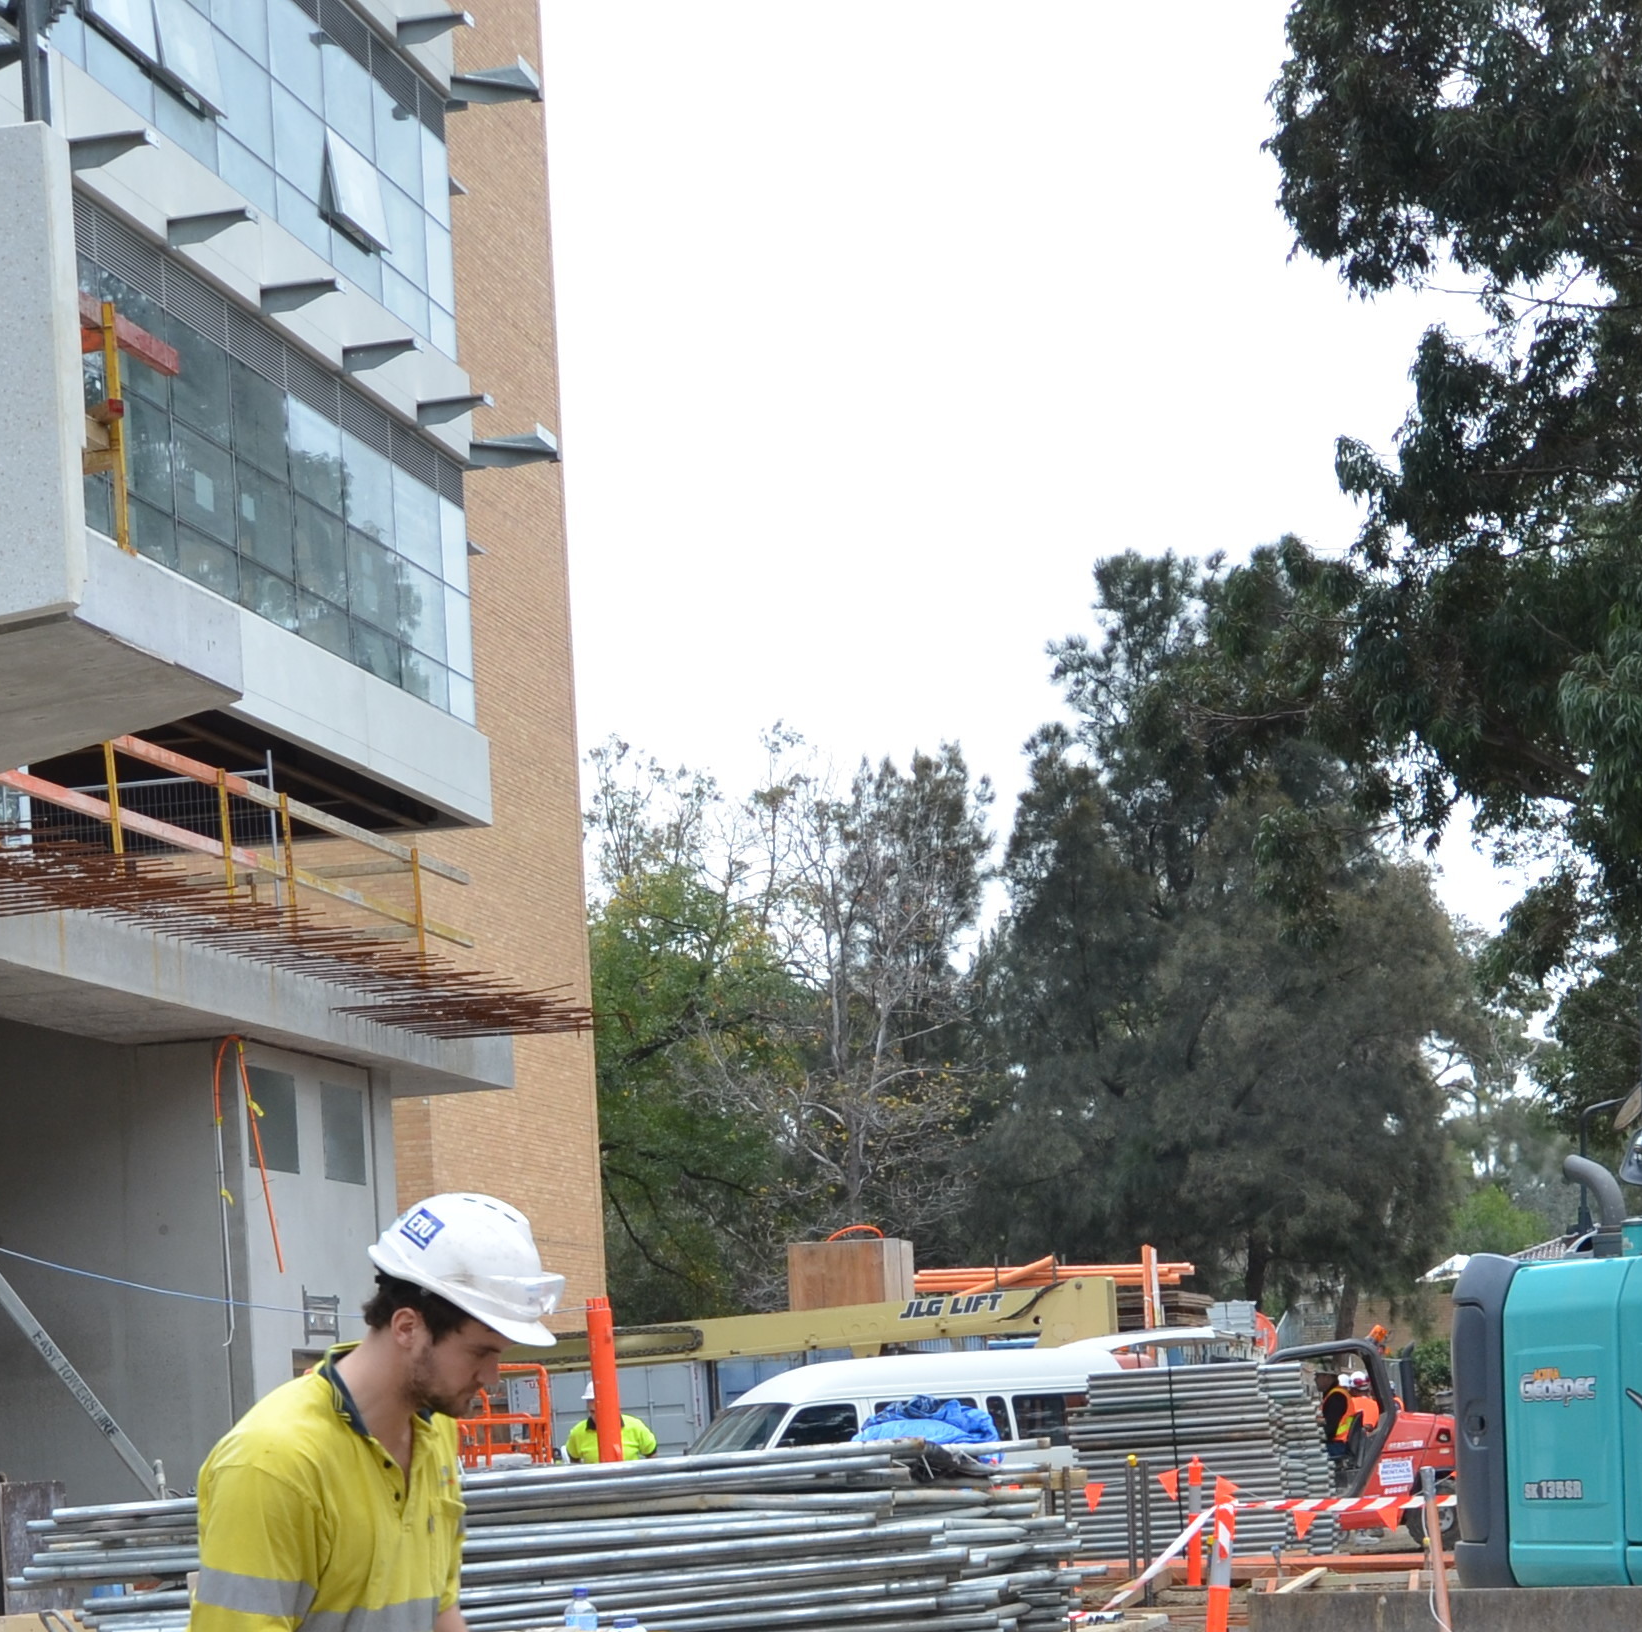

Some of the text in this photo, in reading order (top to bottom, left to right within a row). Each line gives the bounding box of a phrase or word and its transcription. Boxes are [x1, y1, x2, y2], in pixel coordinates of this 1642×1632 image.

[407, 1213, 437, 1238] ETU
[899, 1292, 1004, 1320] JLG LIFT
[32, 1330, 61, 1362] EASY
[57, 1362, 98, 1412] TOWERS
